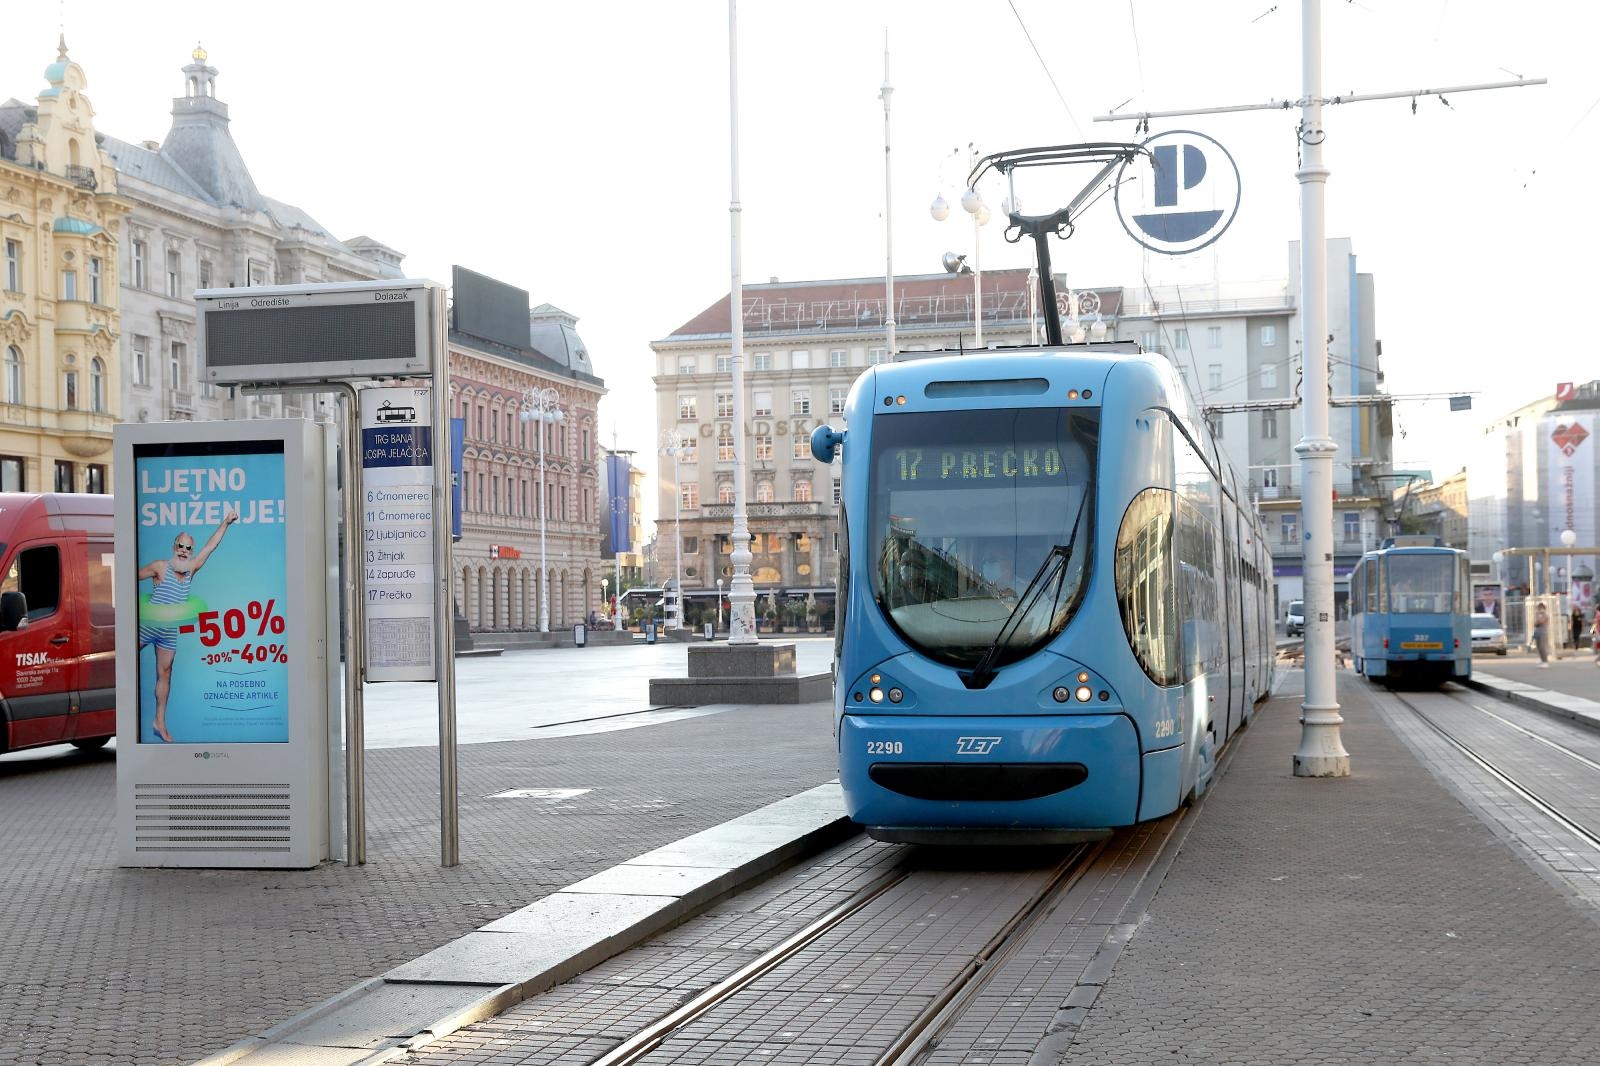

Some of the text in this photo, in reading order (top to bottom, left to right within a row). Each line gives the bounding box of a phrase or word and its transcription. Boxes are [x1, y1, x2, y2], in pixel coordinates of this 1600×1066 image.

[218, 292, 408, 311] Linija Odredište Dolazak
[374, 433, 414, 445] TRG BANA
[364, 444, 429, 460] JOSIPA JELAČIĆA
[896, 448, 923, 480] 17
[141, 467, 246, 494] LJETNO
[367, 490, 430, 503] 6 Črnomerec
[141, 493, 285, 527] SNIŽENJE!
[367, 509, 431, 522] 11 Črnomerec
[365, 529, 427, 541] 12 Ljubljanica
[366, 549, 406, 563] 13 Žitnjak
[366, 568, 375, 580] 14
[368, 589, 412, 601] 17 Prečko
[179, 598, 286, 647] -50%
[15, 652, 48, 667] TISAK
[201, 643, 288, 666] -30% -40%
[216, 680, 266, 688] NA POSEBNO
[203, 690, 279, 700] OZNAČENE ARTIKLE
[866, 736, 1002, 755] 2290 ZET
